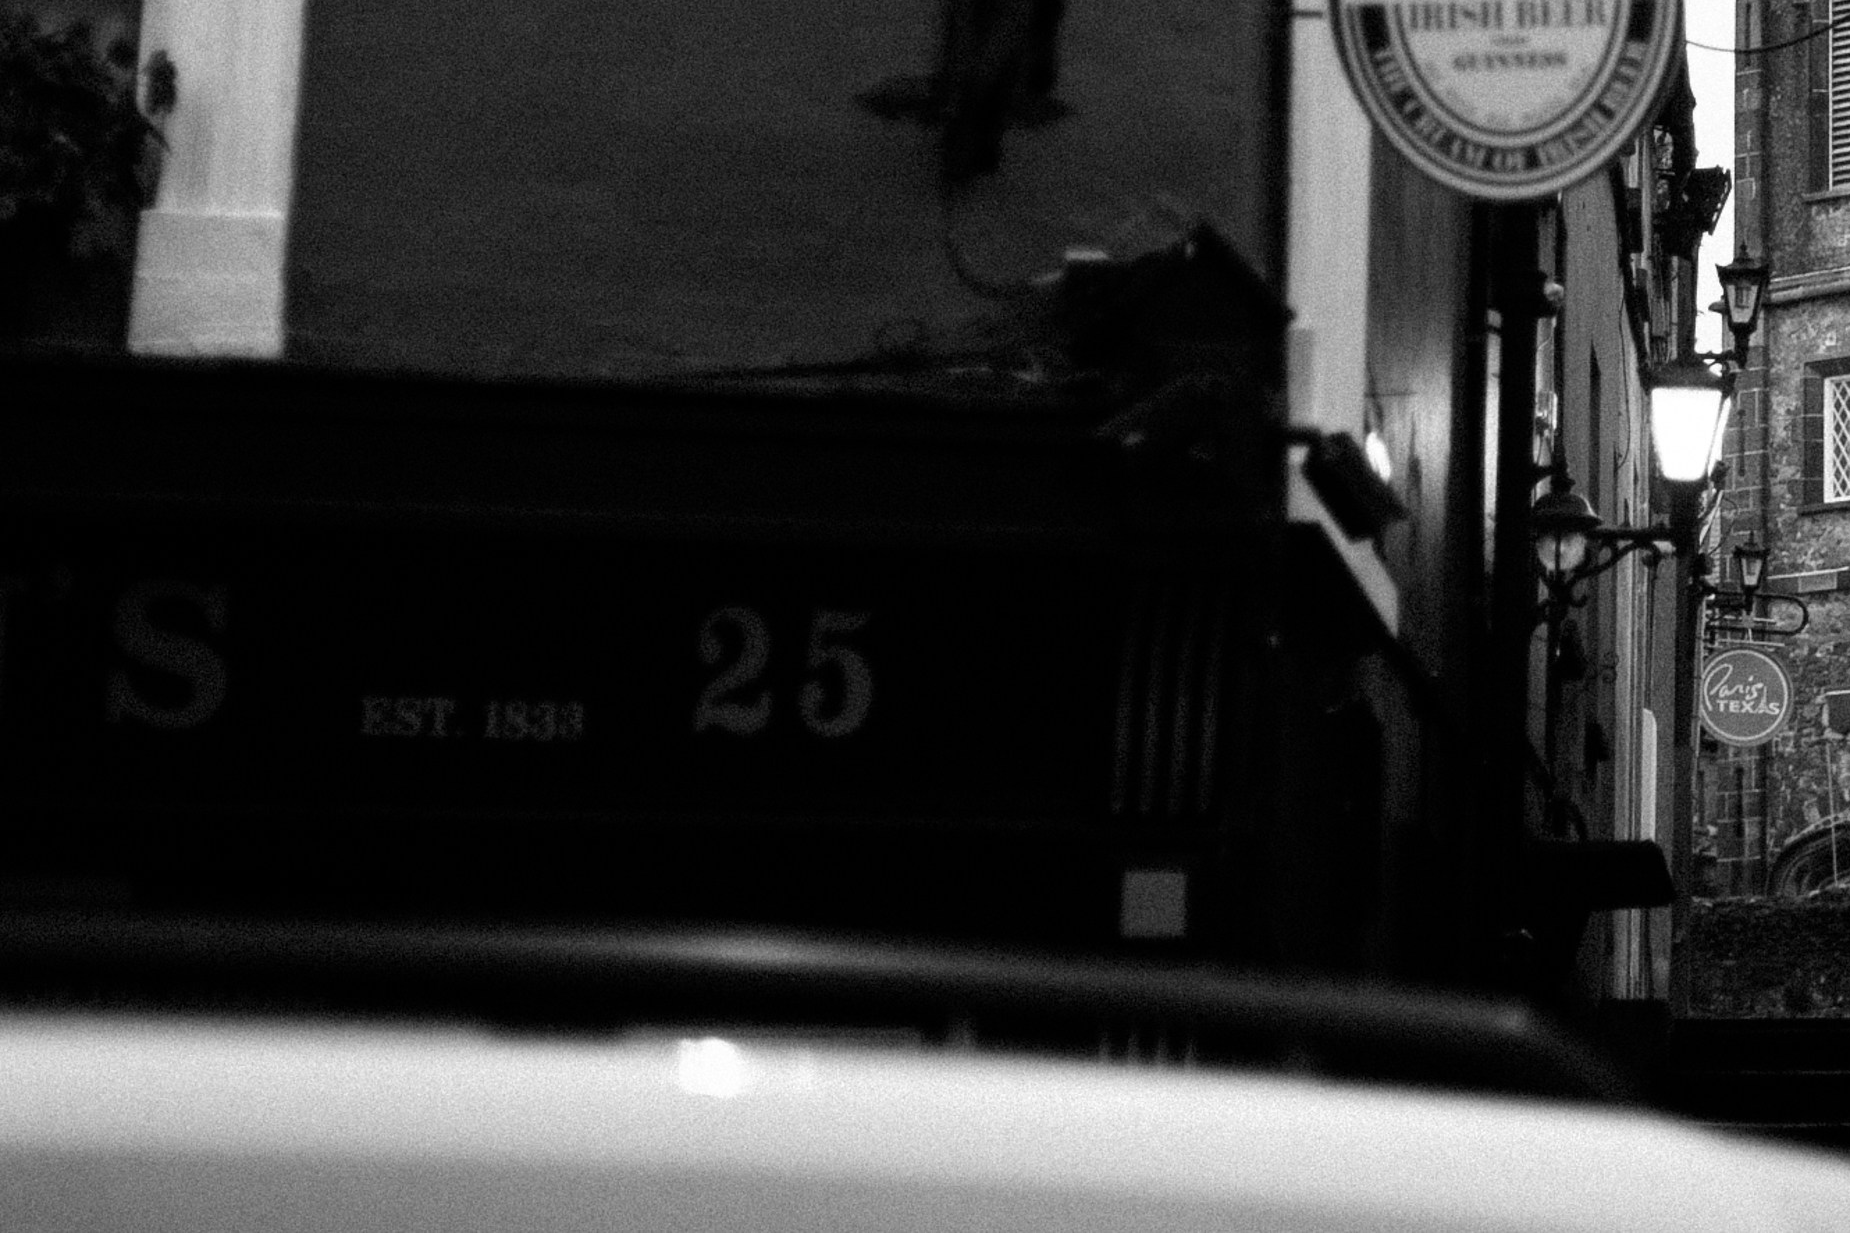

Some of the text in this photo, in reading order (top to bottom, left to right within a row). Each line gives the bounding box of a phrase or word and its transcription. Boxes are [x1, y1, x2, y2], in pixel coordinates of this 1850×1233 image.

[1408, 0, 1504, 32] IRISH
[694, 606, 874, 737] 25
[1703, 663, 1764, 712] Paris
[1716, 691, 1780, 715] TEXAS
